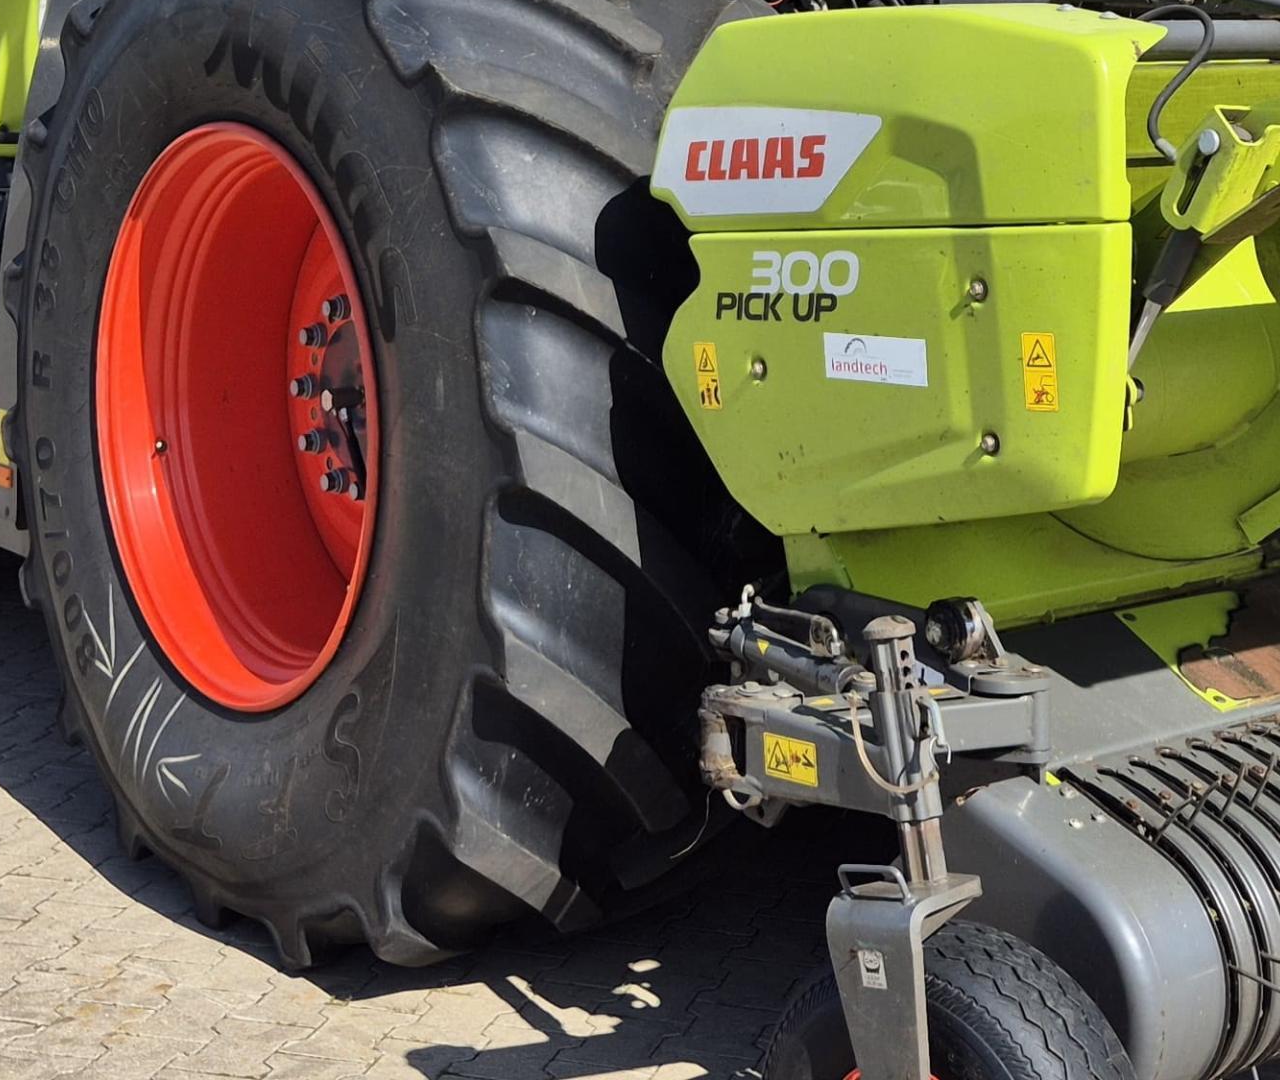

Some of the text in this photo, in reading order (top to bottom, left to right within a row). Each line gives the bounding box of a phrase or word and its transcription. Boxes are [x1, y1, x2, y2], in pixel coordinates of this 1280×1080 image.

[685, 134, 827, 182] CLAAS
[33, 238, 62, 312] 38
[750, 250, 860, 297] 300
[715, 292, 838, 322] PICK UP
[32, 350, 52, 388] R
[831, 357, 888, 376] landtech
[35, 436, 98, 676] 800/70
